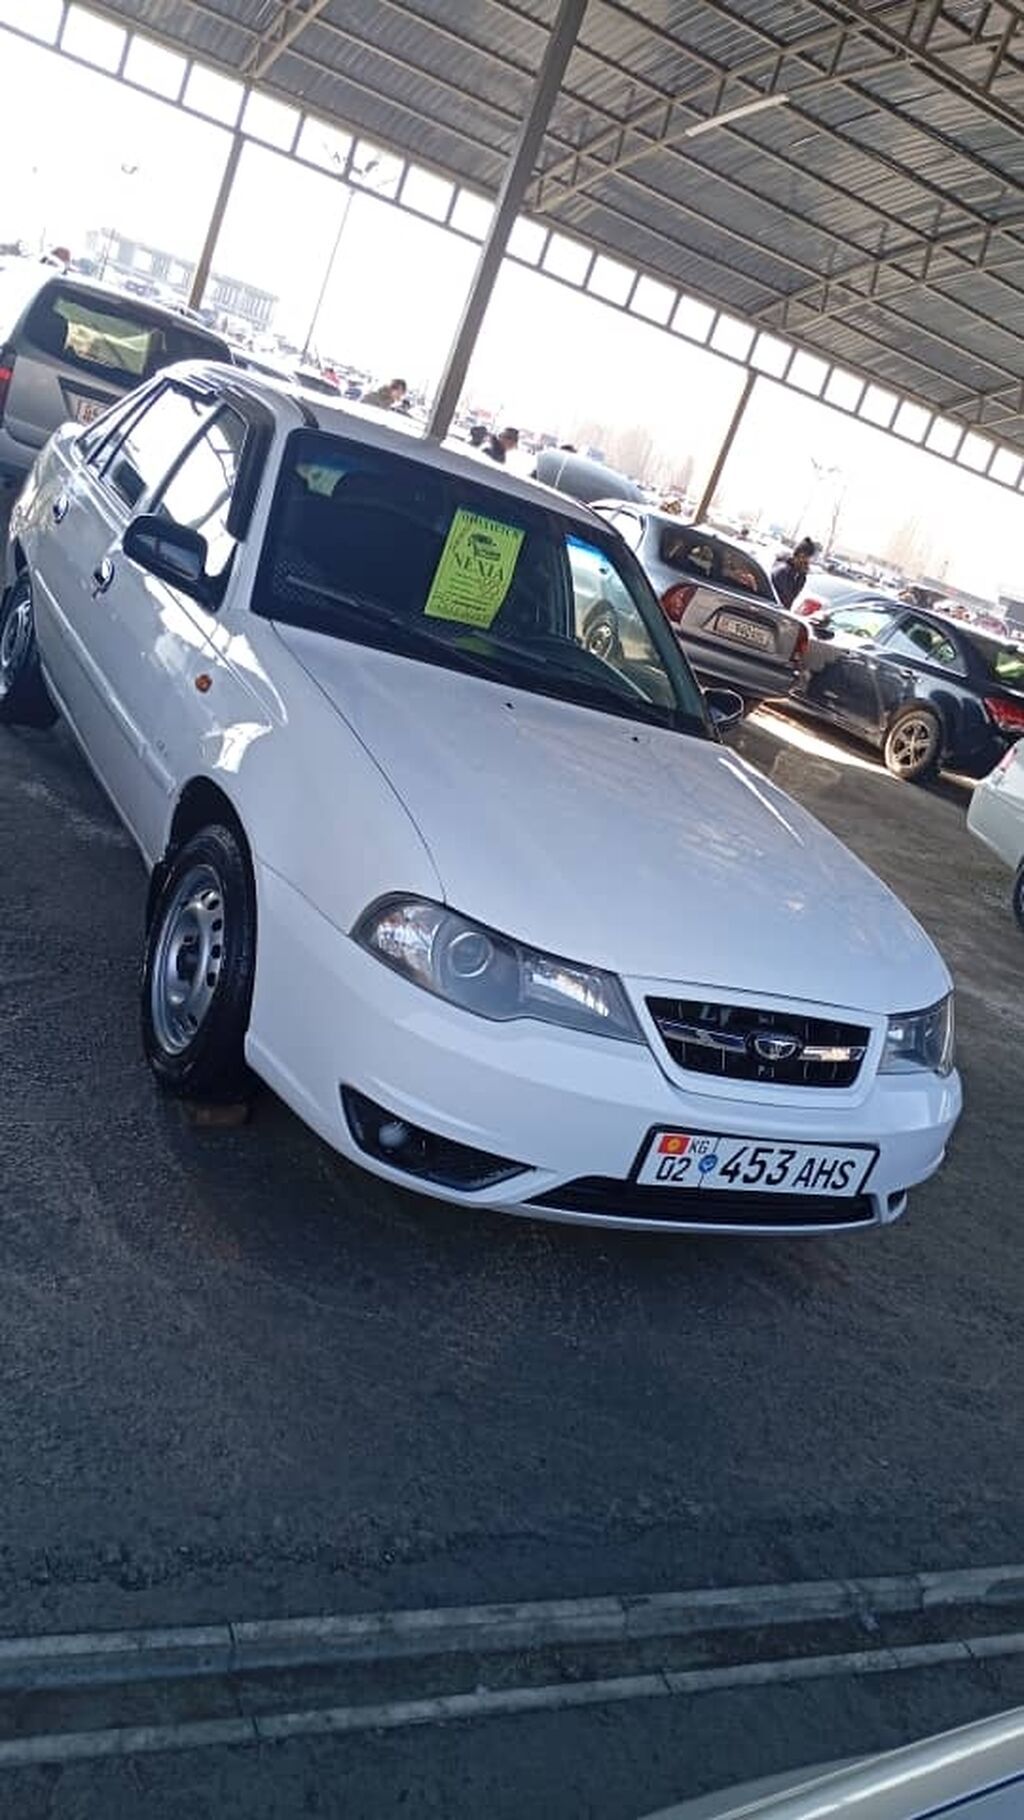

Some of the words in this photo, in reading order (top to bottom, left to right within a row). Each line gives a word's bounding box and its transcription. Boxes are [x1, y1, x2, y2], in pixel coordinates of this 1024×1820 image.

[690, 1140, 710, 1154] KG
[656, 1156, 691, 1182] 02
[719, 1146, 796, 1186] 453
[792, 1157, 856, 1190] AHS
